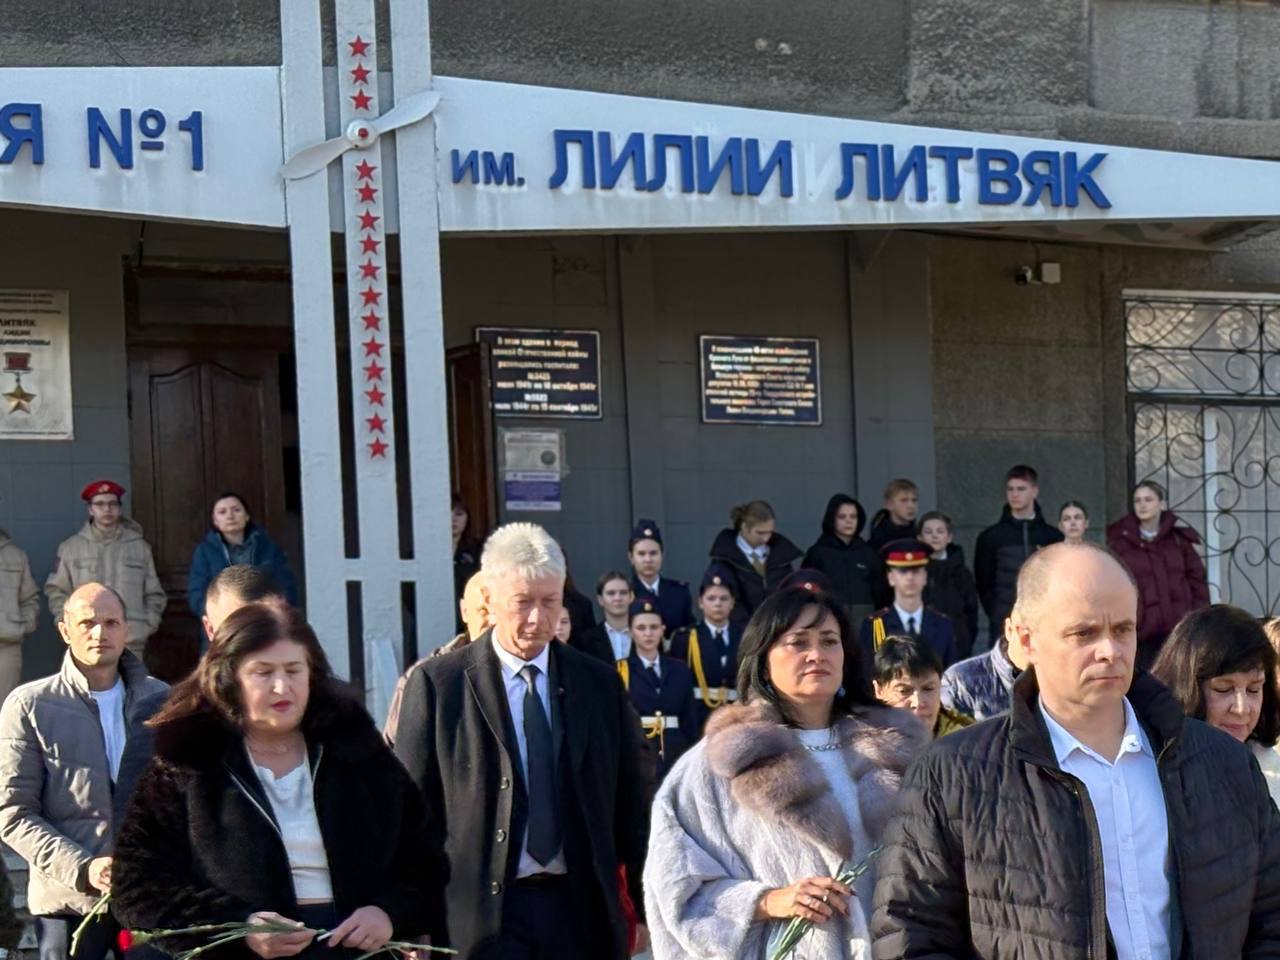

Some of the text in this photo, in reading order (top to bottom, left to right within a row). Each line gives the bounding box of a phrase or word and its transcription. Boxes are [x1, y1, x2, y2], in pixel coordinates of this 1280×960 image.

[452, 129, 1112, 209] им. ЛИЛИИ ЛИТВЯК
